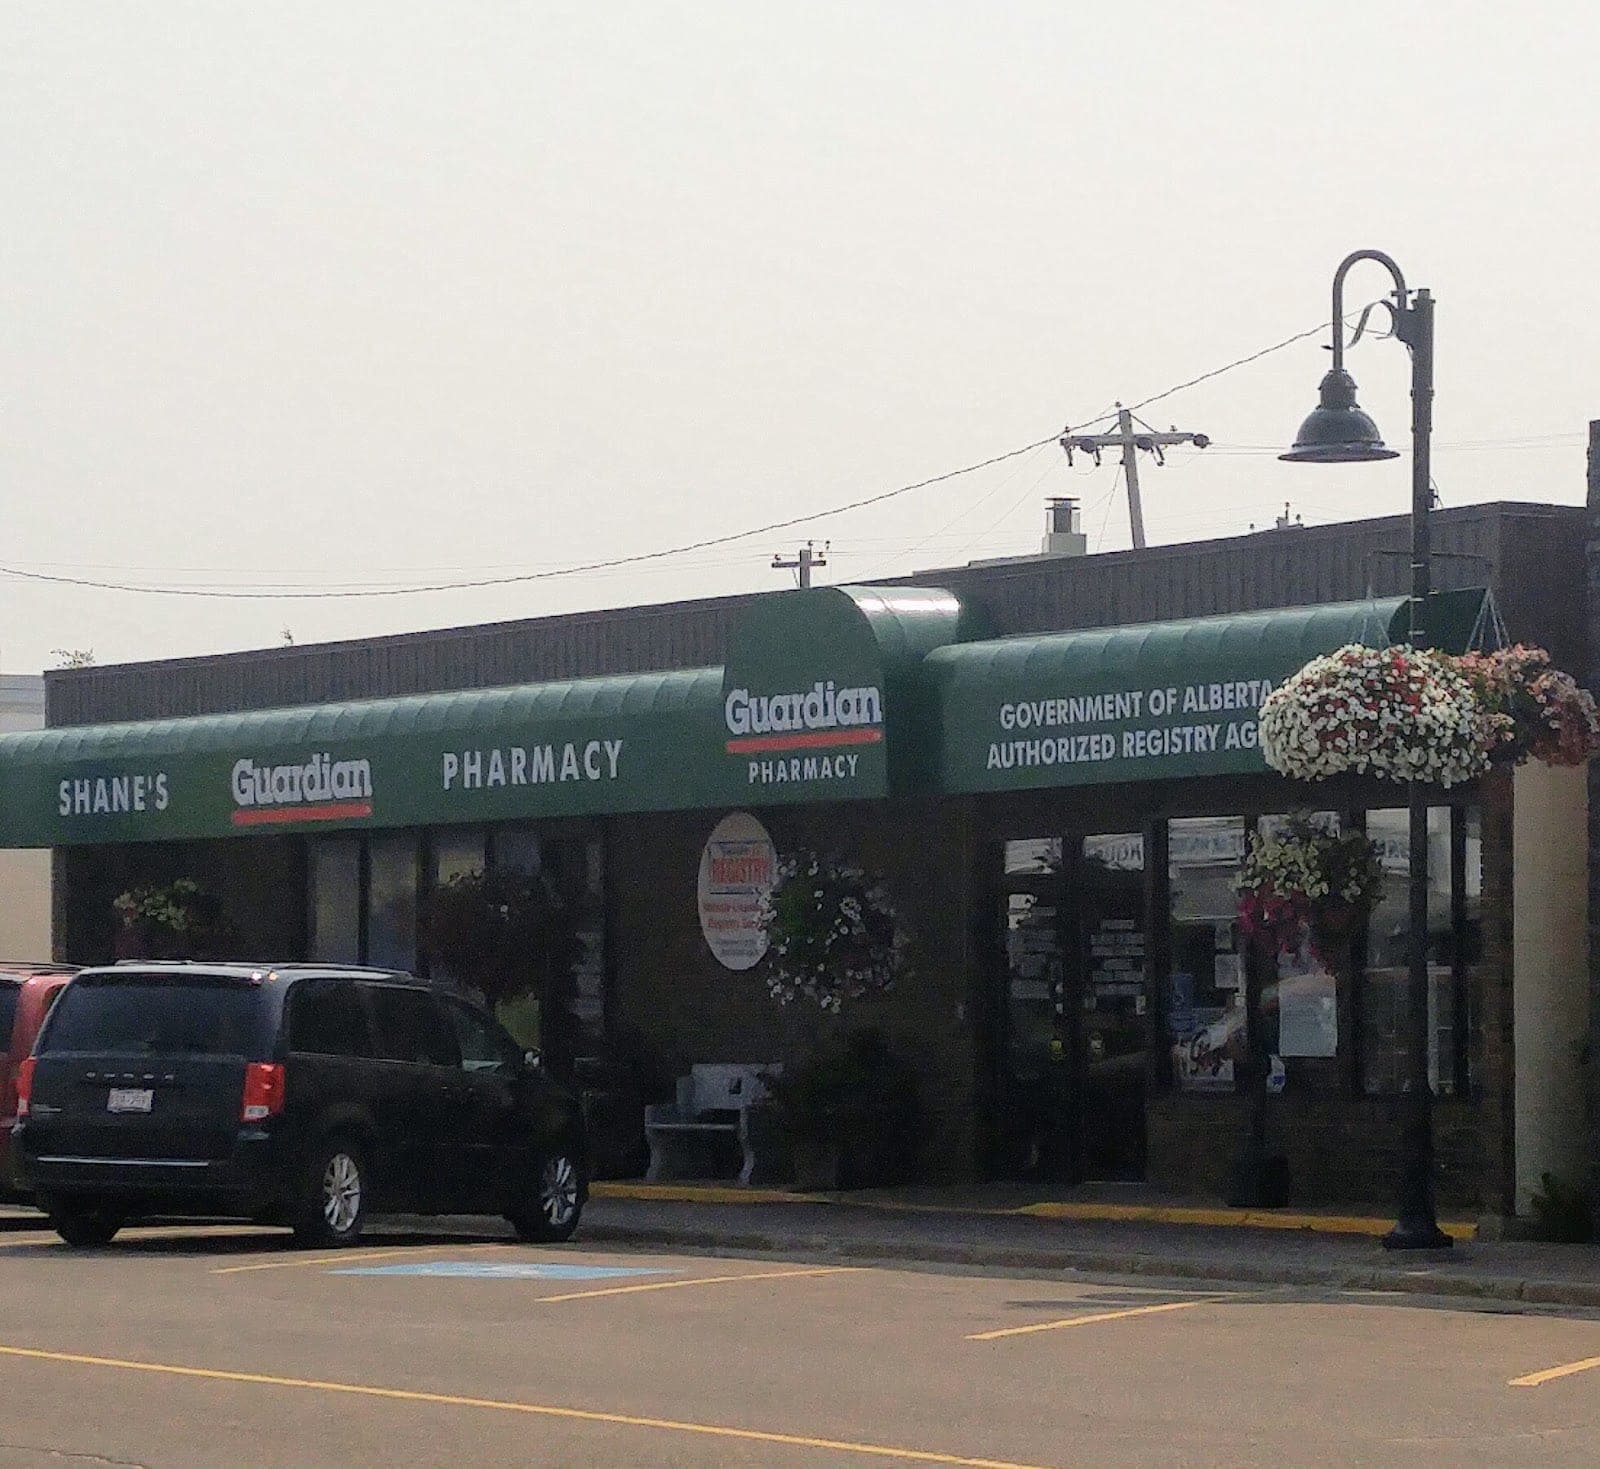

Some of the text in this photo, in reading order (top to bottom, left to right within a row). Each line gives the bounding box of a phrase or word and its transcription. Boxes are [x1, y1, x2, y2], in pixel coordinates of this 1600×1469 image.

[725, 681, 882, 736] Guardian
[1000, 679, 1273, 730] GOVERNMENT OF ALBERTA
[748, 755, 859, 785] PHARMACY
[987, 720, 1264, 769] AUTHORIZED REGISTRY AG
[58, 740, 623, 816] SHANE'S Guardian PHARMACY
